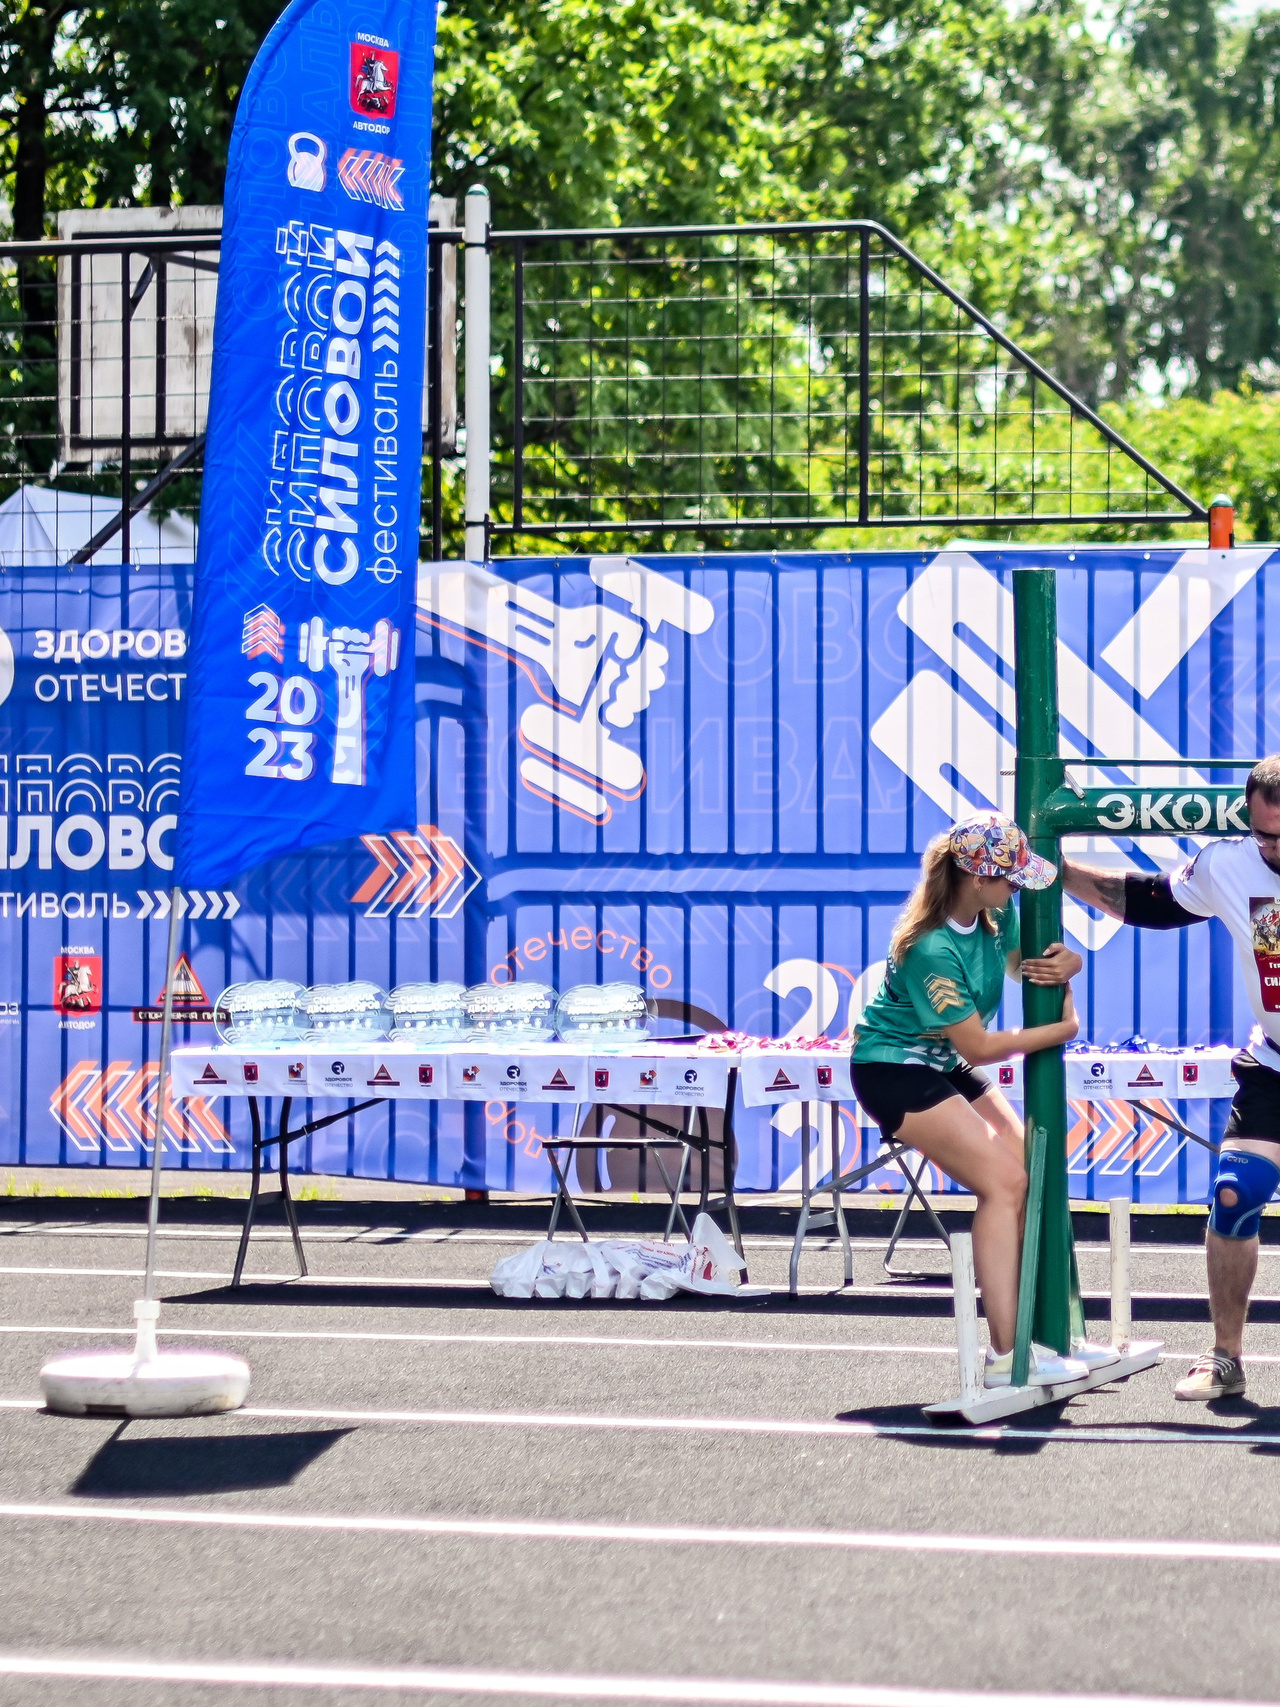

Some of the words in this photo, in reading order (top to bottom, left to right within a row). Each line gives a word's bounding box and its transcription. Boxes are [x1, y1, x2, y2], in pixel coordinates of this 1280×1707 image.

[357, 32, 390, 48] МОСКВА
[352, 120, 391, 135] АВТОДОР
[313, 229, 375, 587] СИЛОВОЙ
[365, 358, 403, 585] фестиваль
[33, 628, 190, 664] ЗДОРОВ
[34, 673, 188, 702] ОТЕЧЕСТ
[245, 671, 321, 726] 20
[244, 727, 316, 781] 23
[0, 814, 179, 871] ЛОВО
[60, 946, 95, 954] МОСКВА
[490, 926, 673, 989] отечество
[58, 1020, 97, 1030] АВТОДОР
